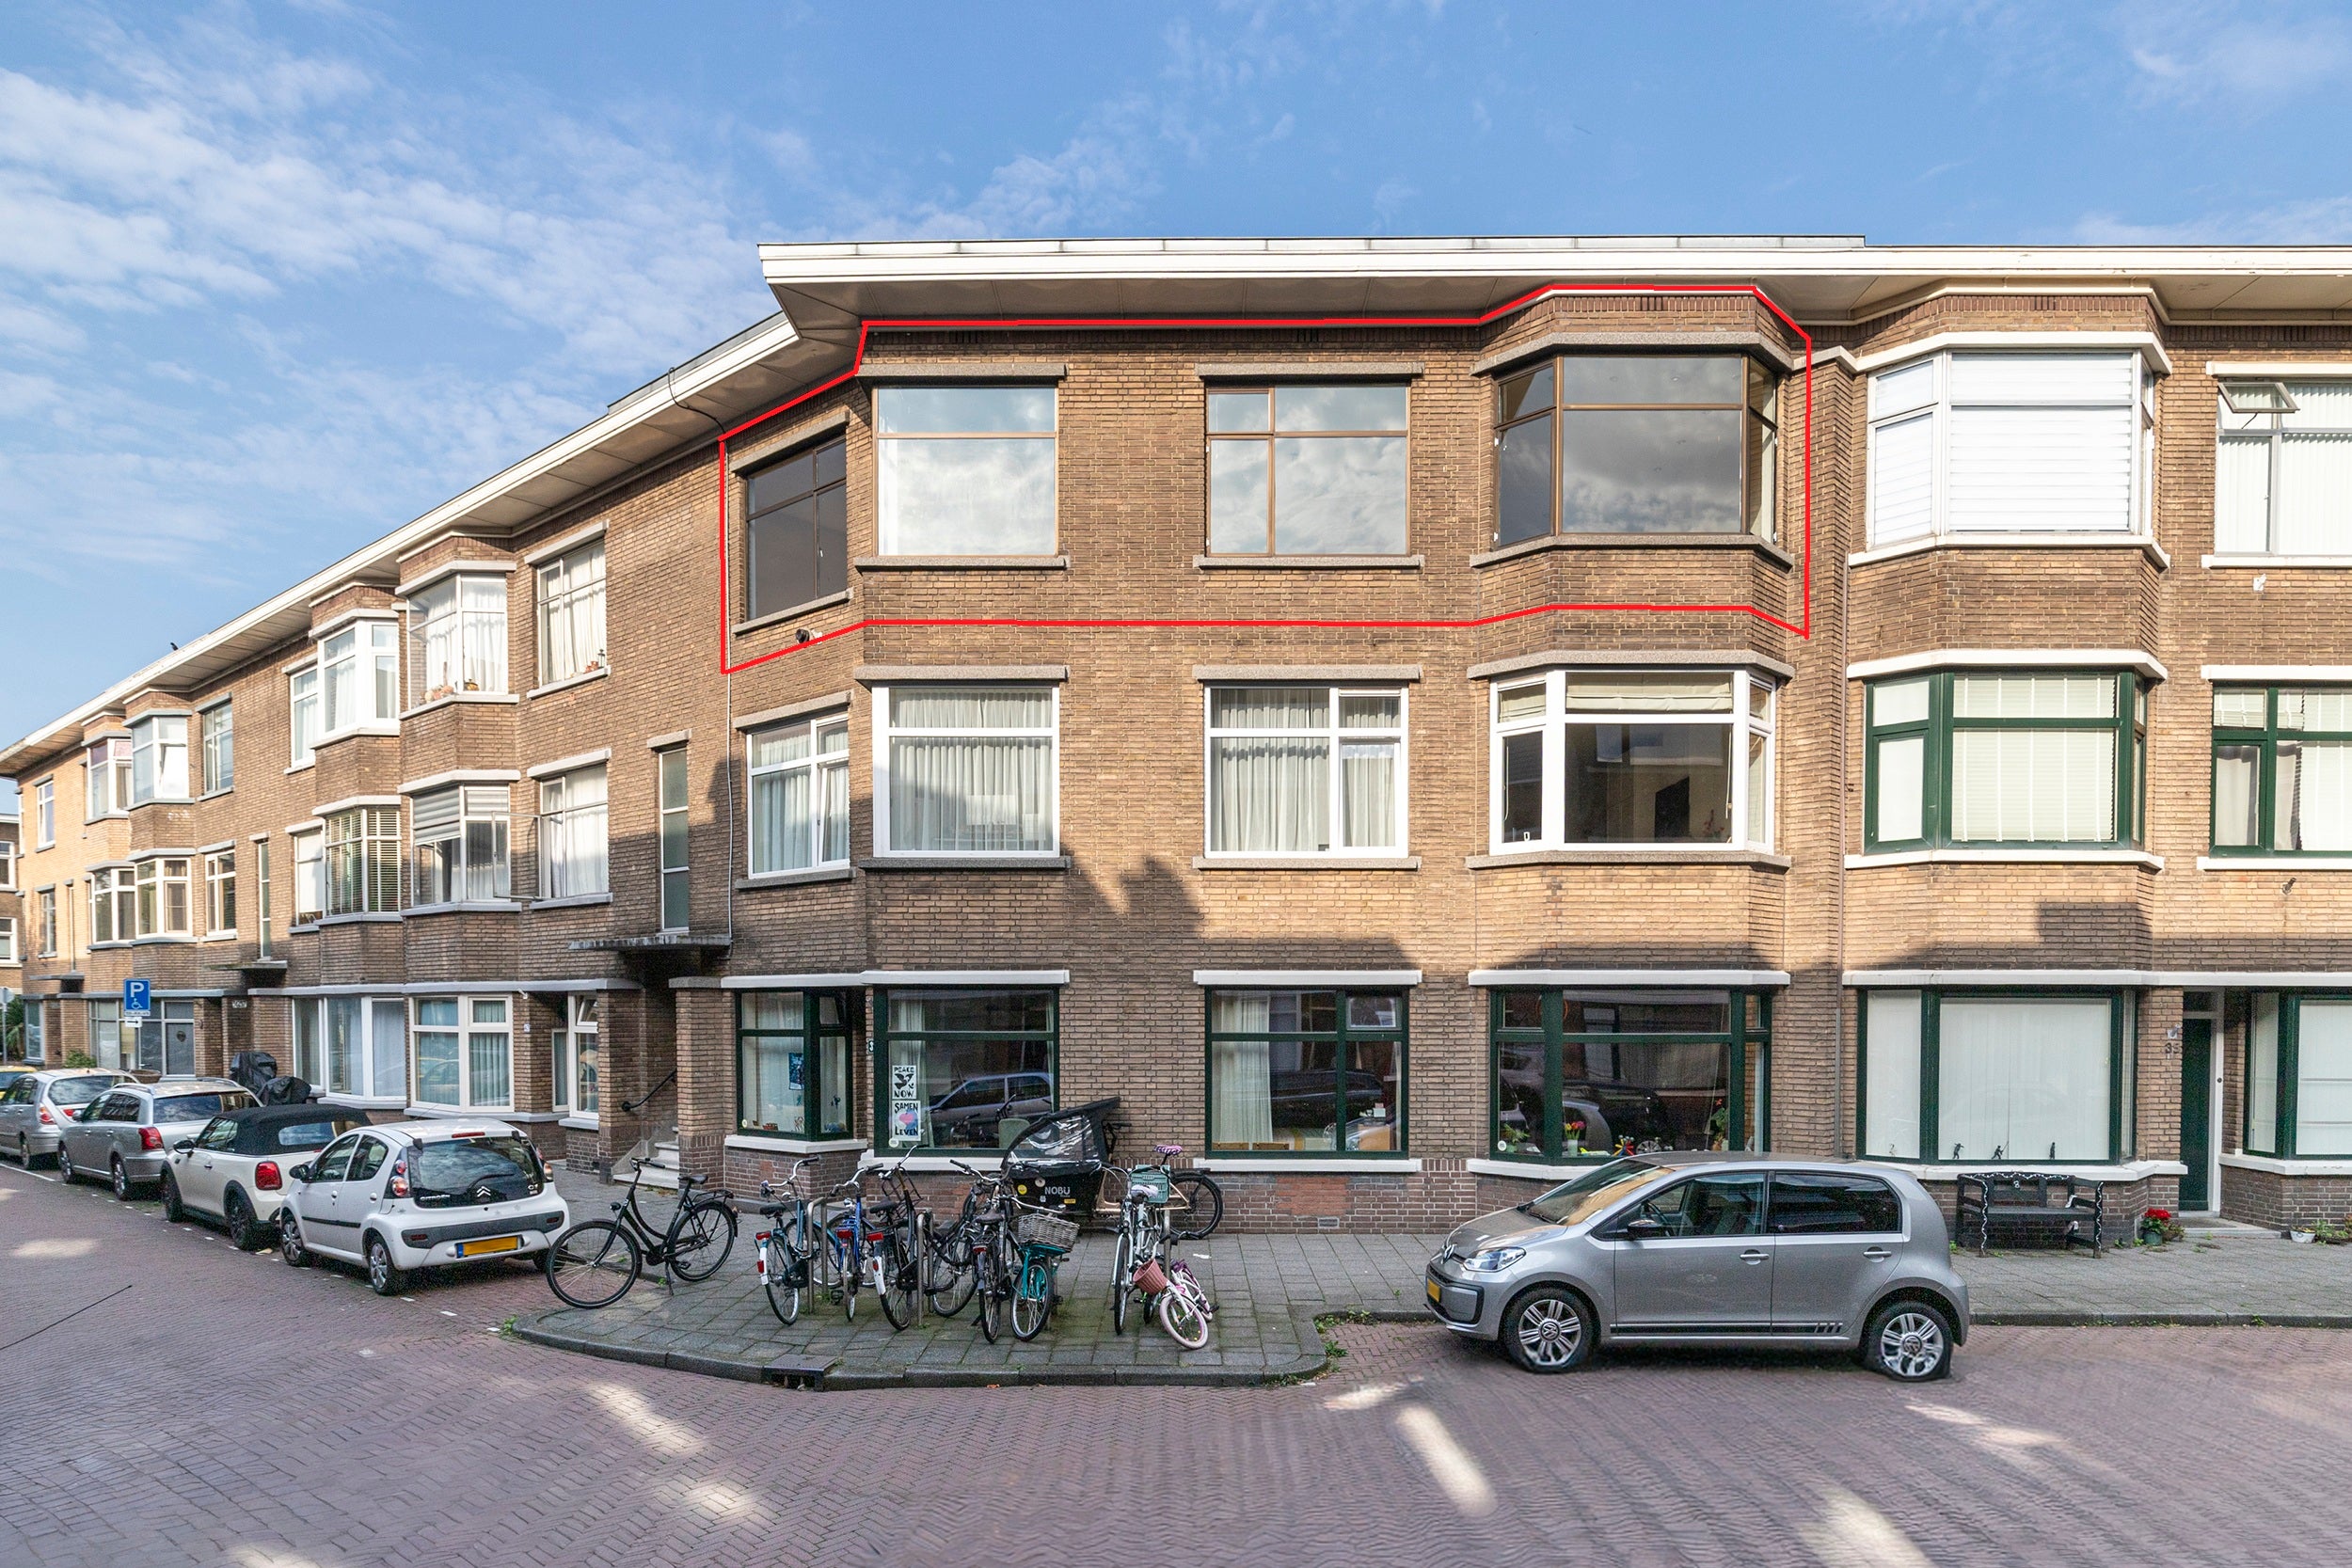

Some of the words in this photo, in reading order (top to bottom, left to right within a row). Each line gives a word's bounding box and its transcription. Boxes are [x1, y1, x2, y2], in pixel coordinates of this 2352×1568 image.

[130, 982, 144, 998] P
[894, 1101, 918, 1114] SAMEN
[895, 1126, 918, 1136] LEVEN
[1044, 1186, 1071, 1196] NOBU
